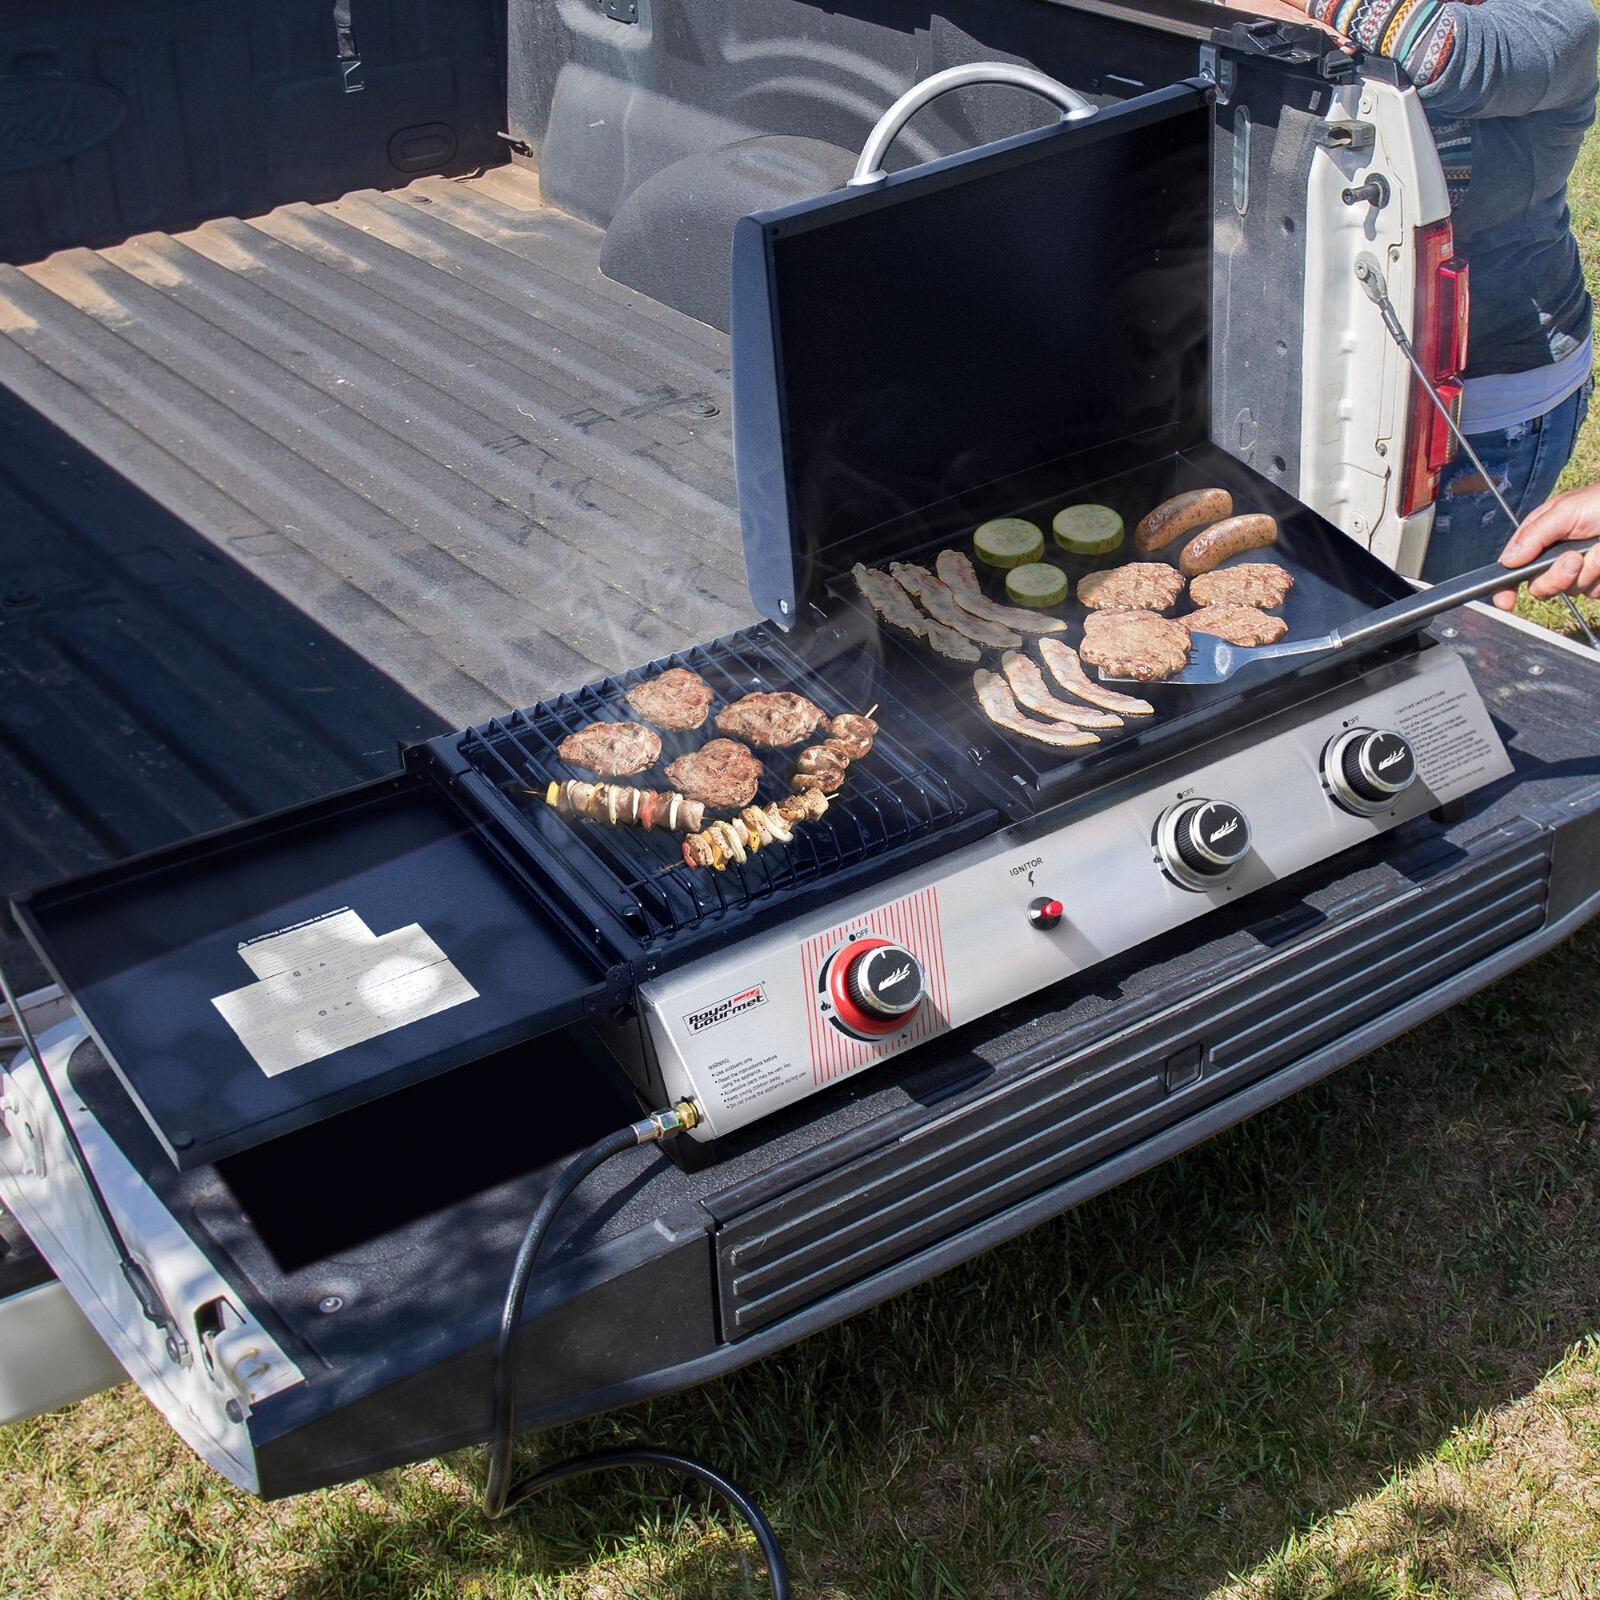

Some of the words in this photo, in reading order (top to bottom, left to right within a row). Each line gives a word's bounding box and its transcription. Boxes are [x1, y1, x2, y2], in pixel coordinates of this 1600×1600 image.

[1347, 715, 1359, 726] OFF
[1182, 786, 1194, 797] OFF
[1009, 857, 1044, 877] IGNITOR
[855, 927, 869, 939] OFF
[689, 999, 732, 1025] Royal
[694, 995, 765, 1031] Gourmet
